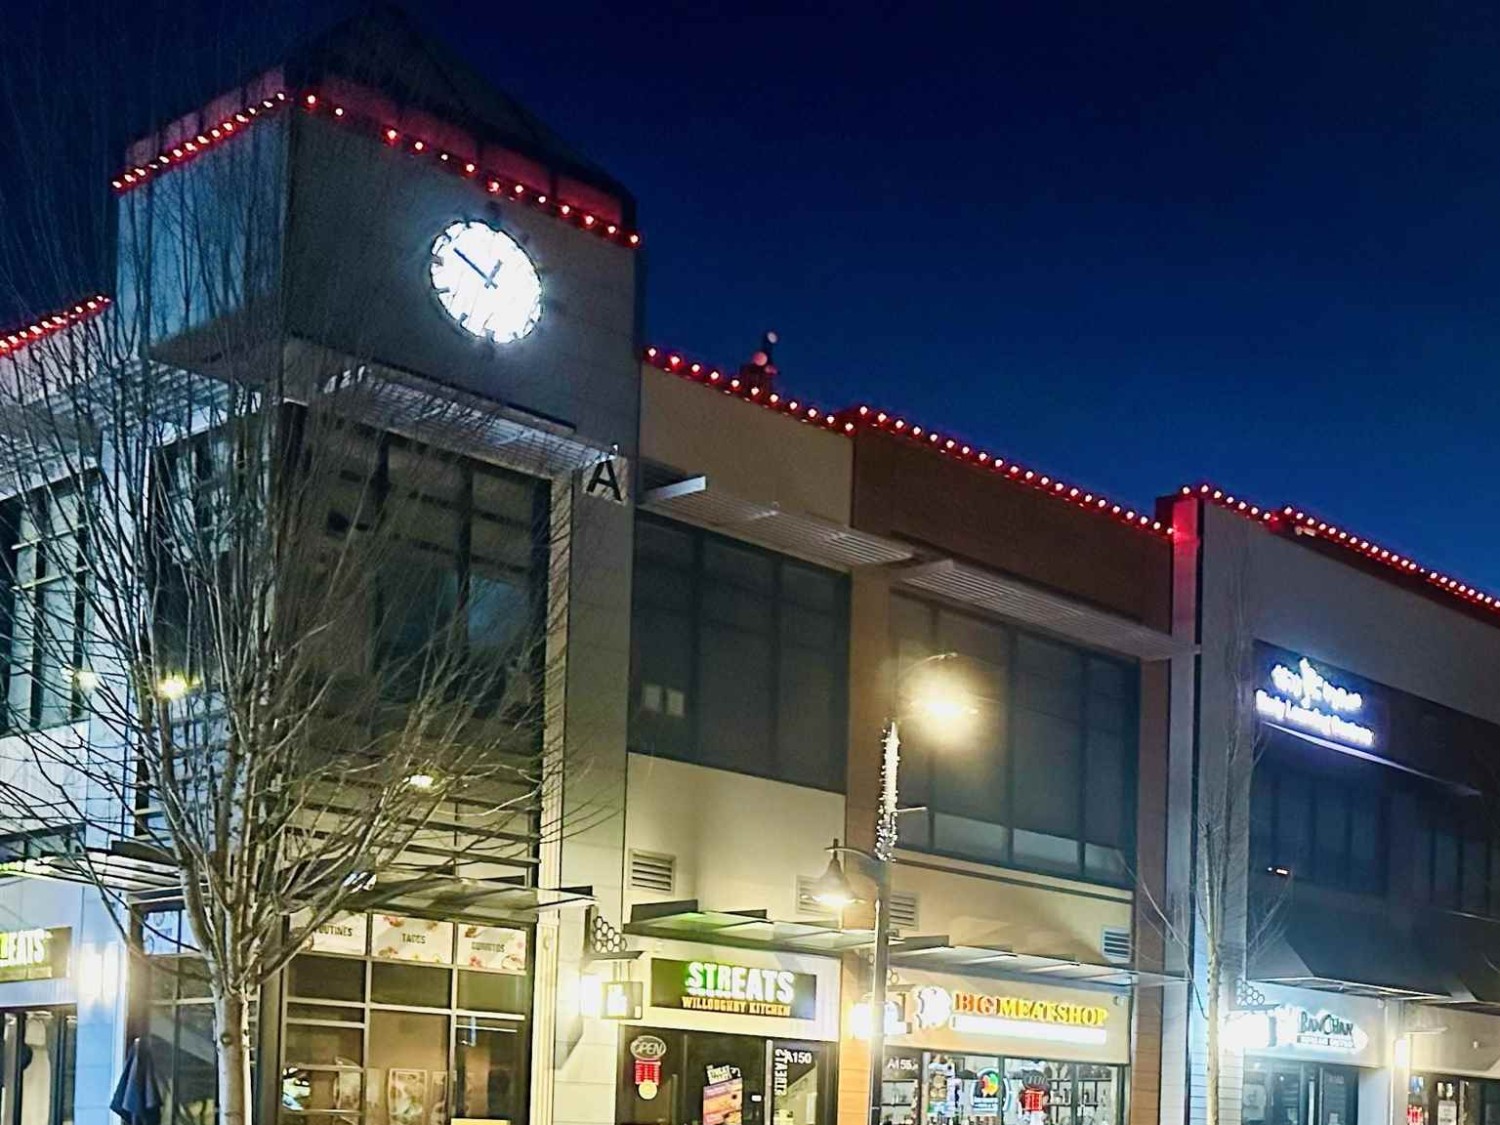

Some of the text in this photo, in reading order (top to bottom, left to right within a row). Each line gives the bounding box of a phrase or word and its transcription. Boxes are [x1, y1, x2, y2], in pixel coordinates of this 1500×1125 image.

[586, 460, 622, 501] A
[0, 929, 46, 966] EATS
[313, 923, 353, 937] OUTINES
[685, 961, 795, 1004] STREATS
[785, 1050, 812, 1064] A150
